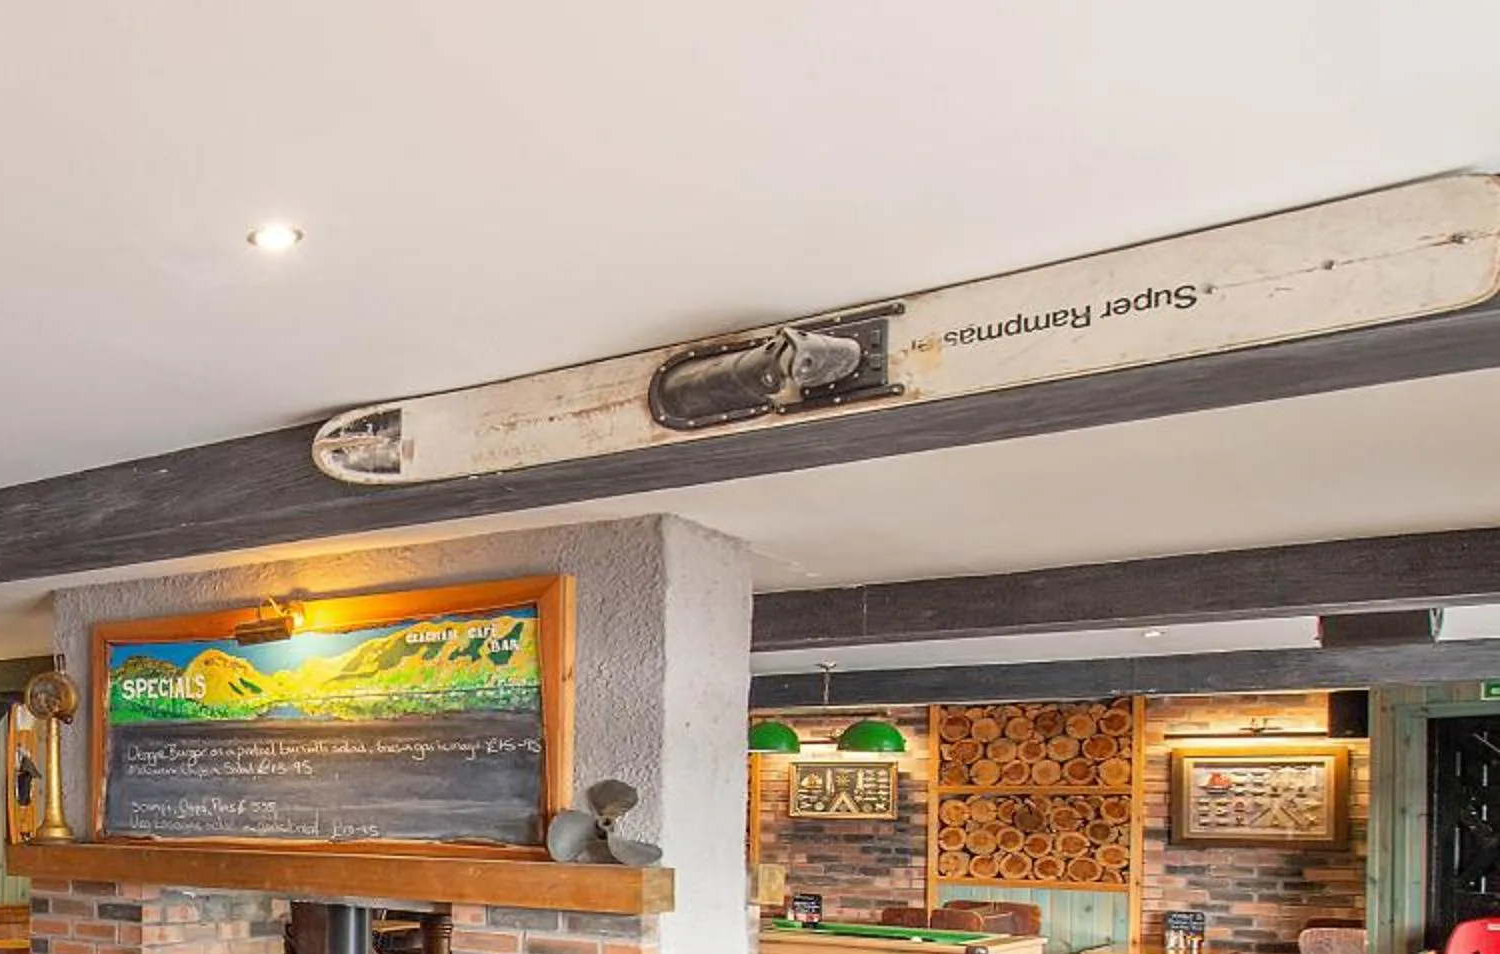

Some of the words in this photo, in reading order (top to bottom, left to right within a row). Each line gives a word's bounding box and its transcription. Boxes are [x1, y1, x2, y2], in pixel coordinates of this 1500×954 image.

[1100, 283, 1198, 319] Super
[910, 304, 1092, 353] Rampmaser
[491, 638, 519, 652] BAR
[122, 674, 207, 700] SPECIALS
